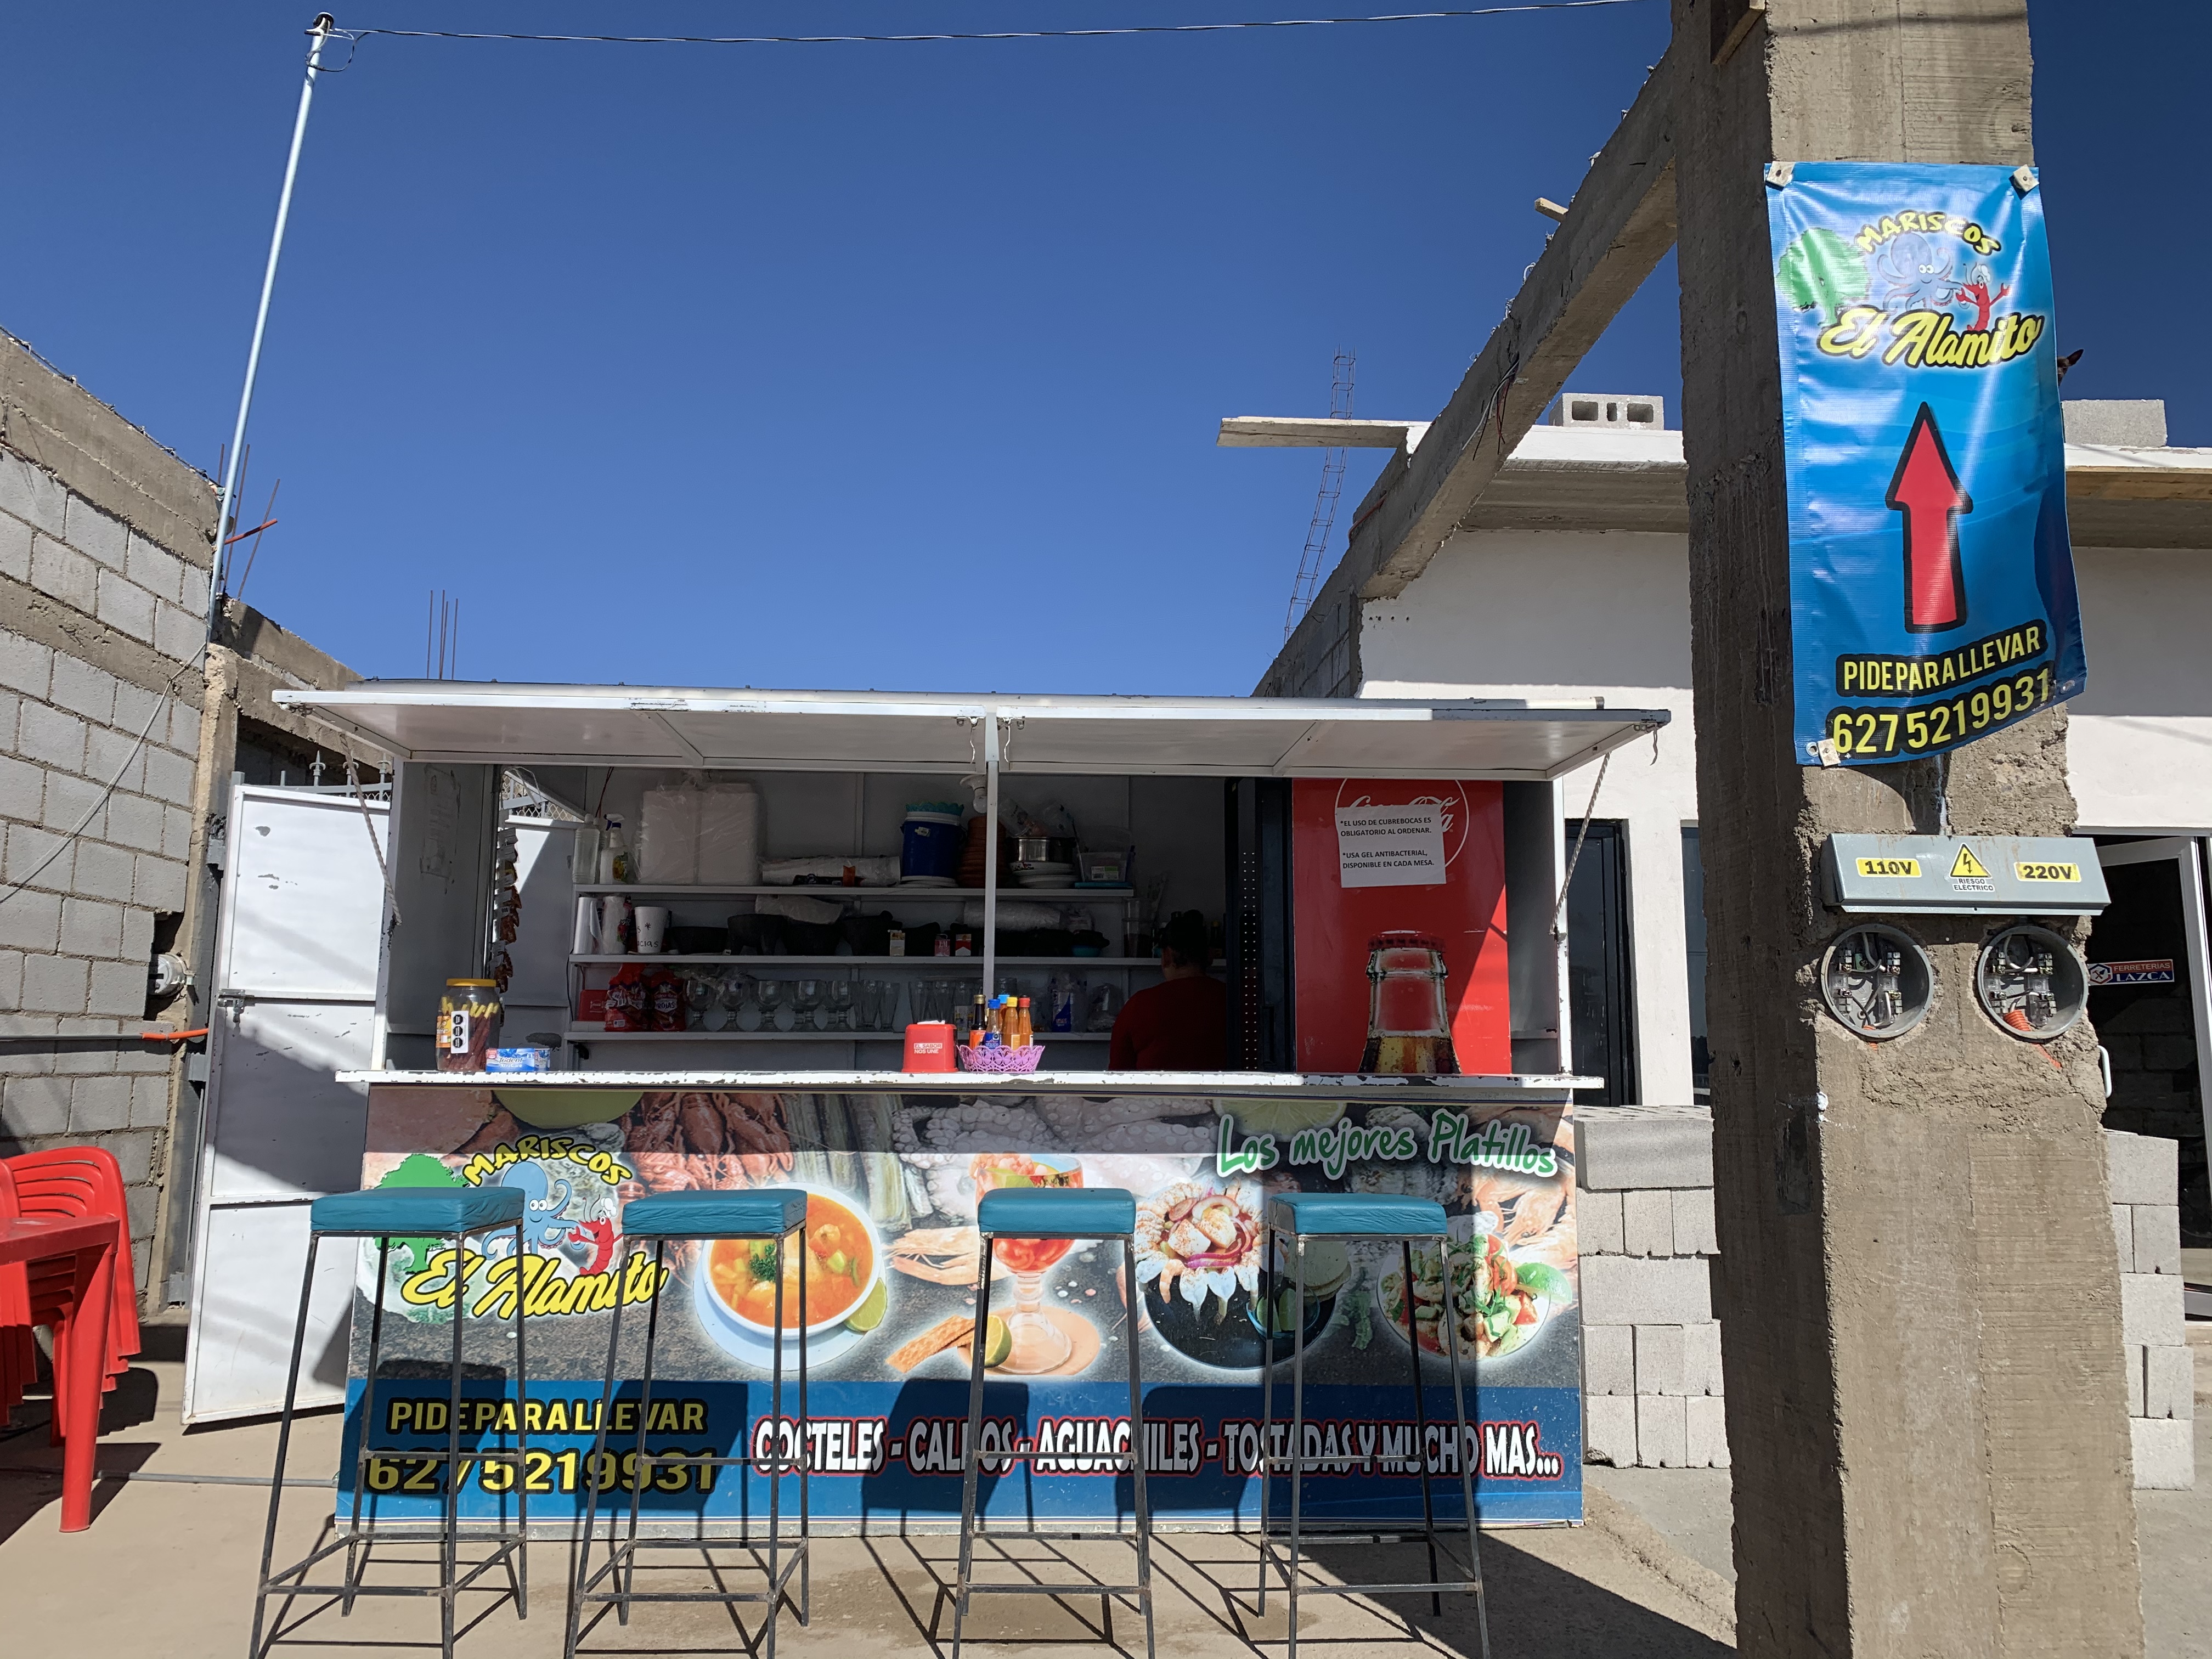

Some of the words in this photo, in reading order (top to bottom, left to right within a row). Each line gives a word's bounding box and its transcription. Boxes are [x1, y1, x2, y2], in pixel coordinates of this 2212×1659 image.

[1855, 211, 2001, 256] MARISCOS
[1818, 305, 1889, 359] El
[1882, 309, 2044, 369] Alamito
[1865, 861, 1912, 876] 110V
[2023, 865, 2073, 880] 220V
[2115, 971, 2171, 982] LAZCA
[462, 1136, 633, 1185] MARISCOS
[1218, 1115, 1278, 1176] Los
[1291, 1117, 1416, 1180] mejores
[1429, 1109, 1556, 1176] Platillos
